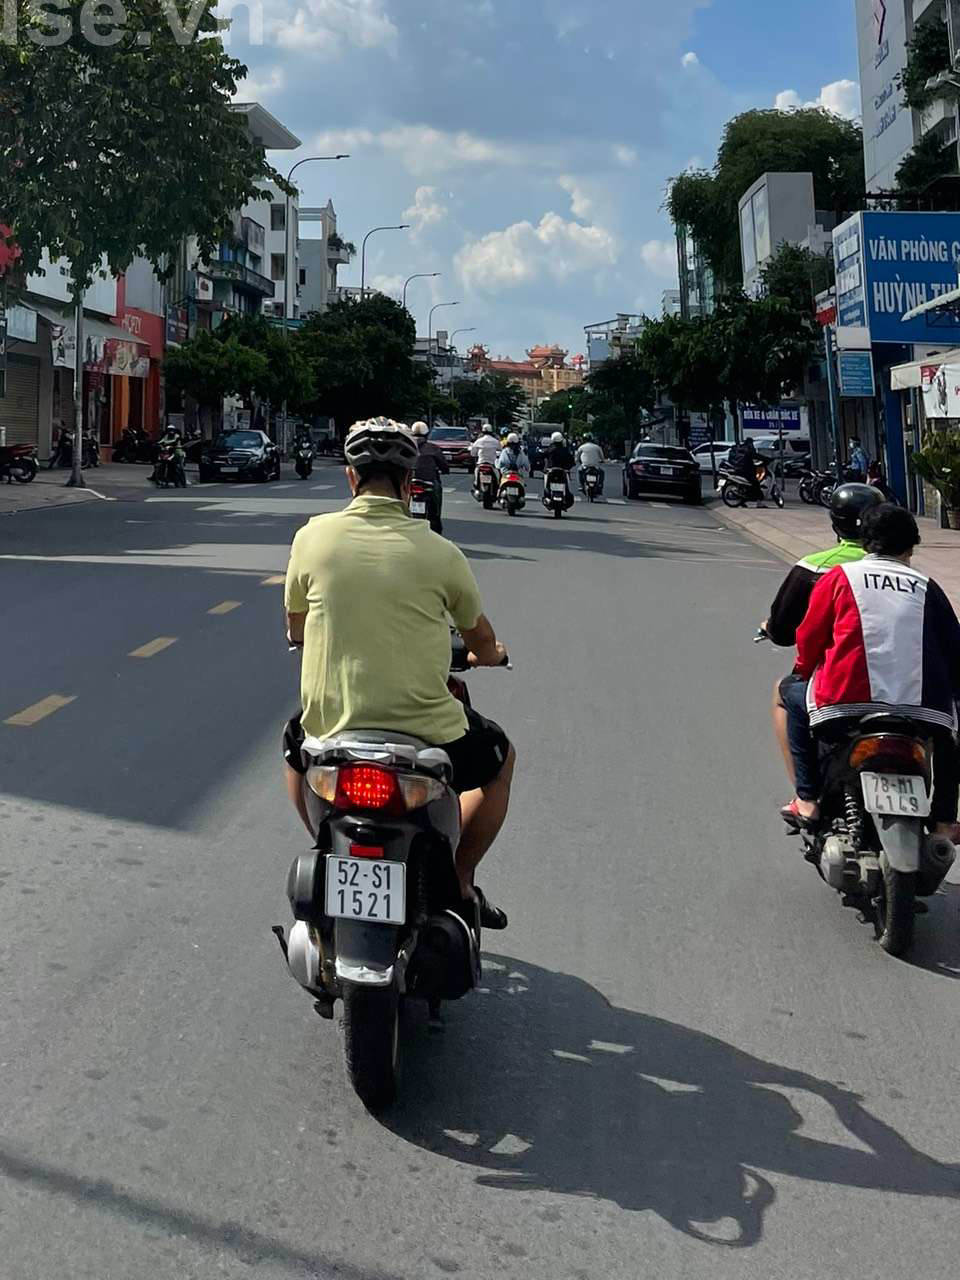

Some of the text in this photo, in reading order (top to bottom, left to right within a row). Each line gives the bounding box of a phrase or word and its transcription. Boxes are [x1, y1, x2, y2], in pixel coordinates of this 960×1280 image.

[869, 235, 897, 261] VĂN
[901, 234, 949, 262] PHÒNG
[873, 273, 927, 313] HUỲNH
[863, 573, 920, 594] ITALY
[337, 860, 391, 890] 52-S1
[337, 889, 391, 919] 1521
